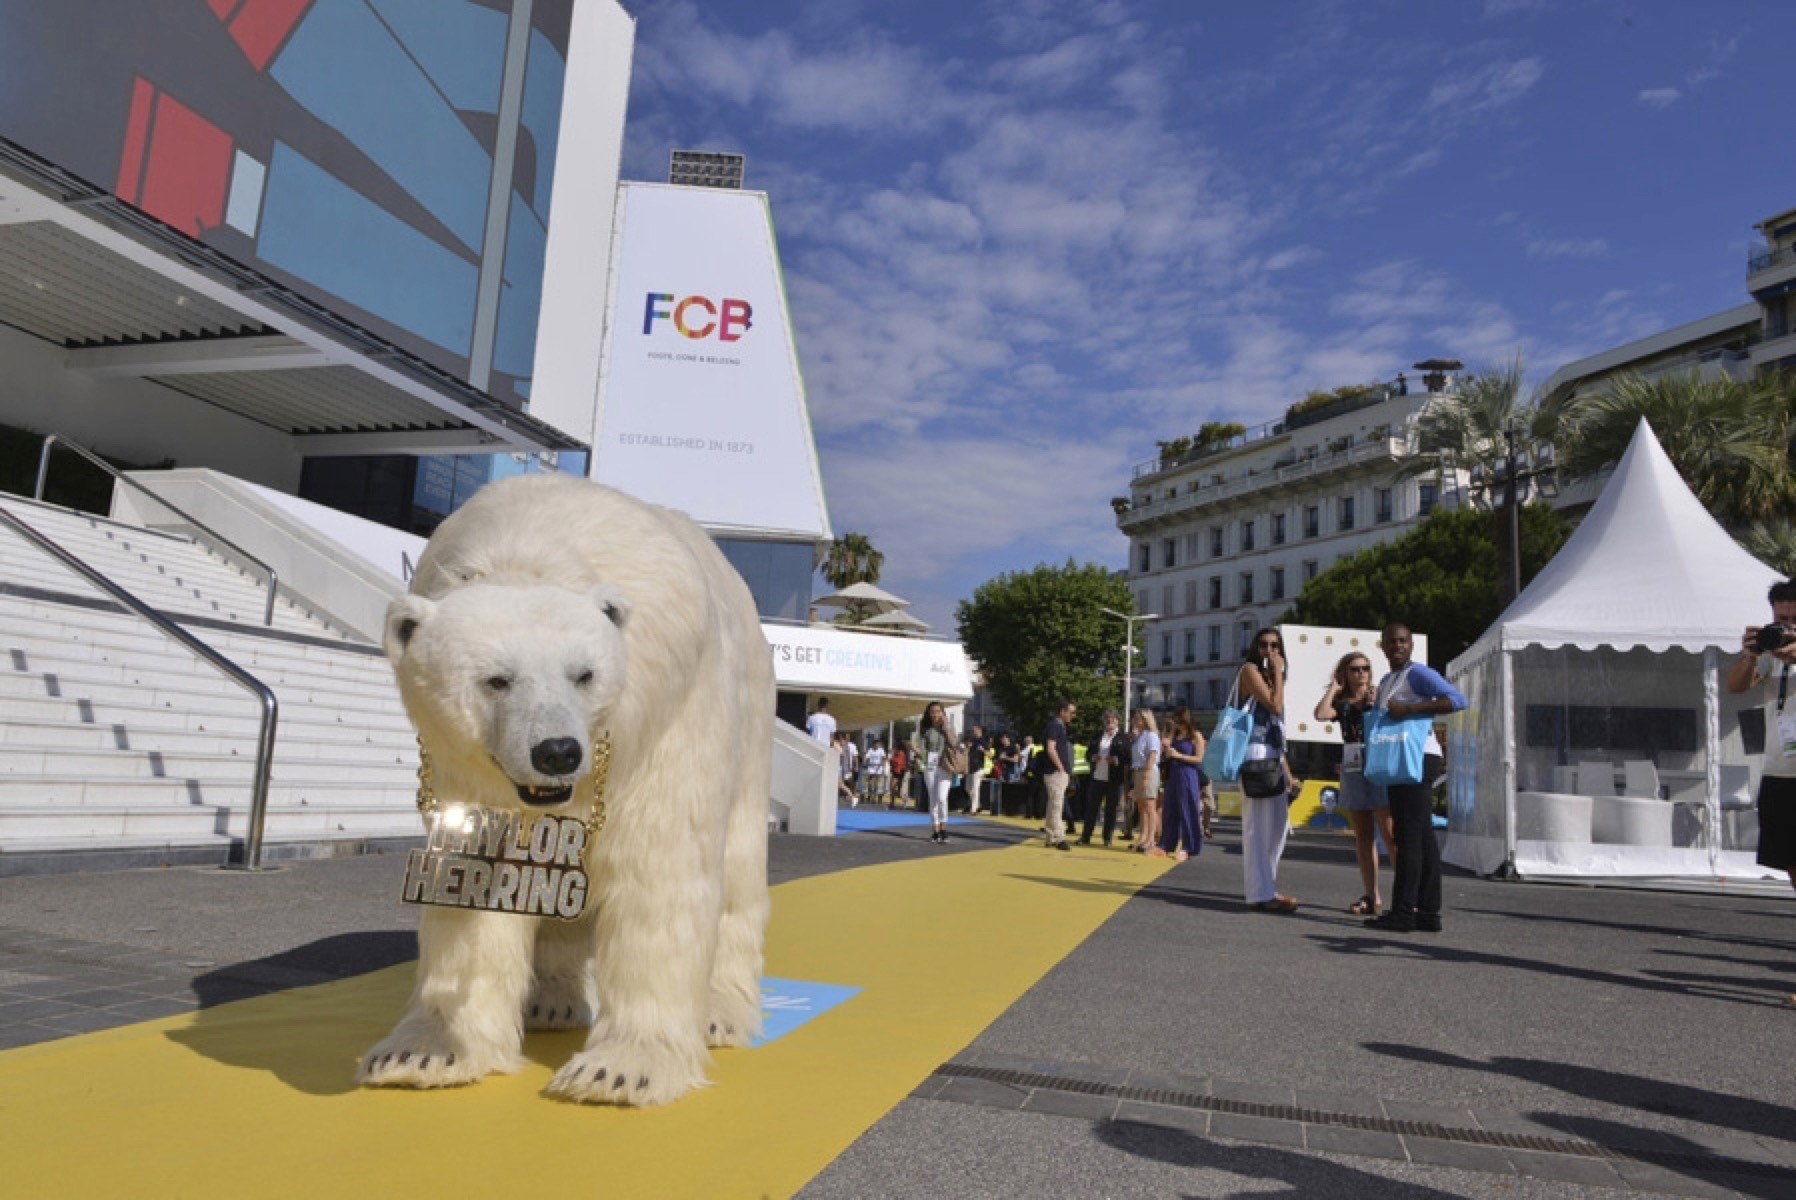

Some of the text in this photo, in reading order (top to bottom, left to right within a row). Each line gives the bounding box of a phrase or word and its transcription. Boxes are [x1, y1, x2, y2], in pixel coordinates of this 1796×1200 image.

[642, 292, 753, 342] FCB
[619, 433, 754, 454] ESTABLISHED IN 1873
[795, 646, 822, 664] GET
[826, 649, 894, 671] CREATIVE
[402, 848, 589, 921] HERRING
